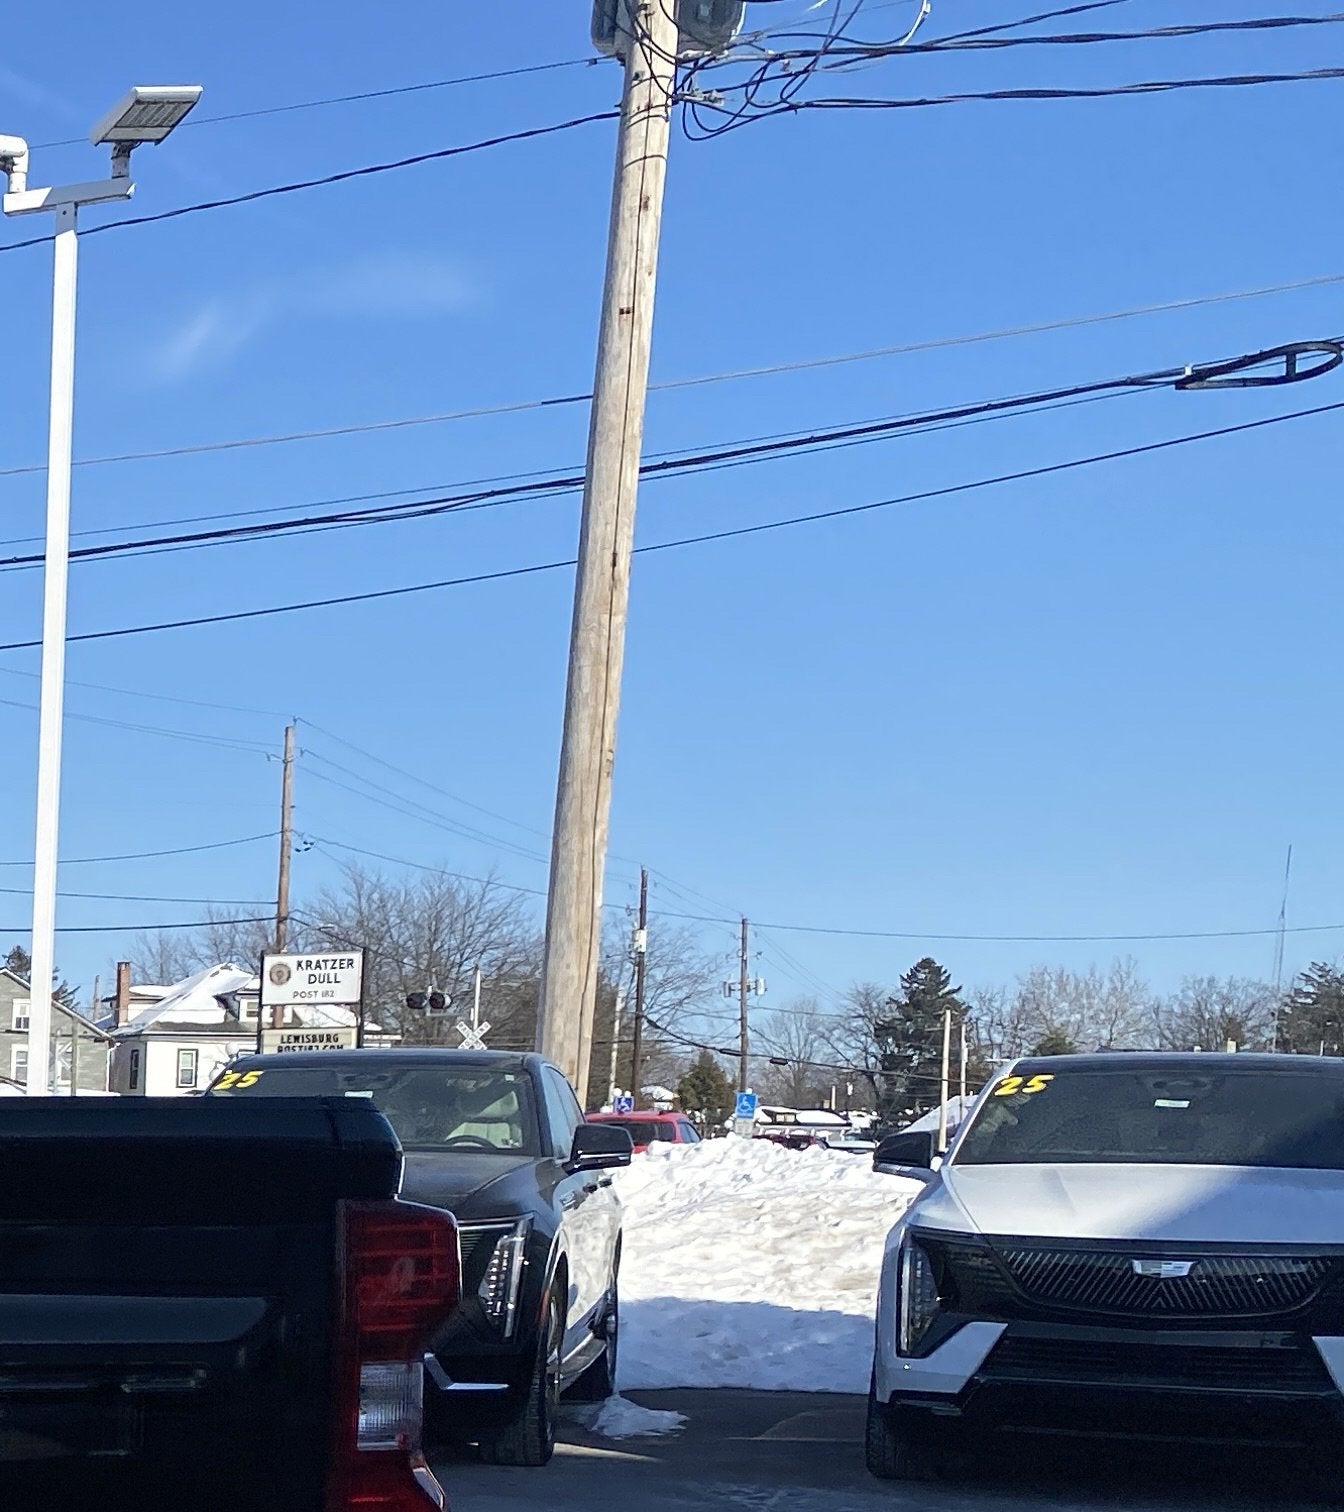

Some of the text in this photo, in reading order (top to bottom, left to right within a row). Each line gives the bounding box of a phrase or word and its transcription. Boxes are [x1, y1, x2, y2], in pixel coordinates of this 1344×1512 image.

[296, 958, 354, 971] KRATZER
[308, 973, 342, 985] DULL
[292, 990, 319, 999] POST
[280, 1034, 339, 1044] LEWISBURG
[213, 1070, 265, 1090] 25
[994, 1074, 1055, 1096] 25
